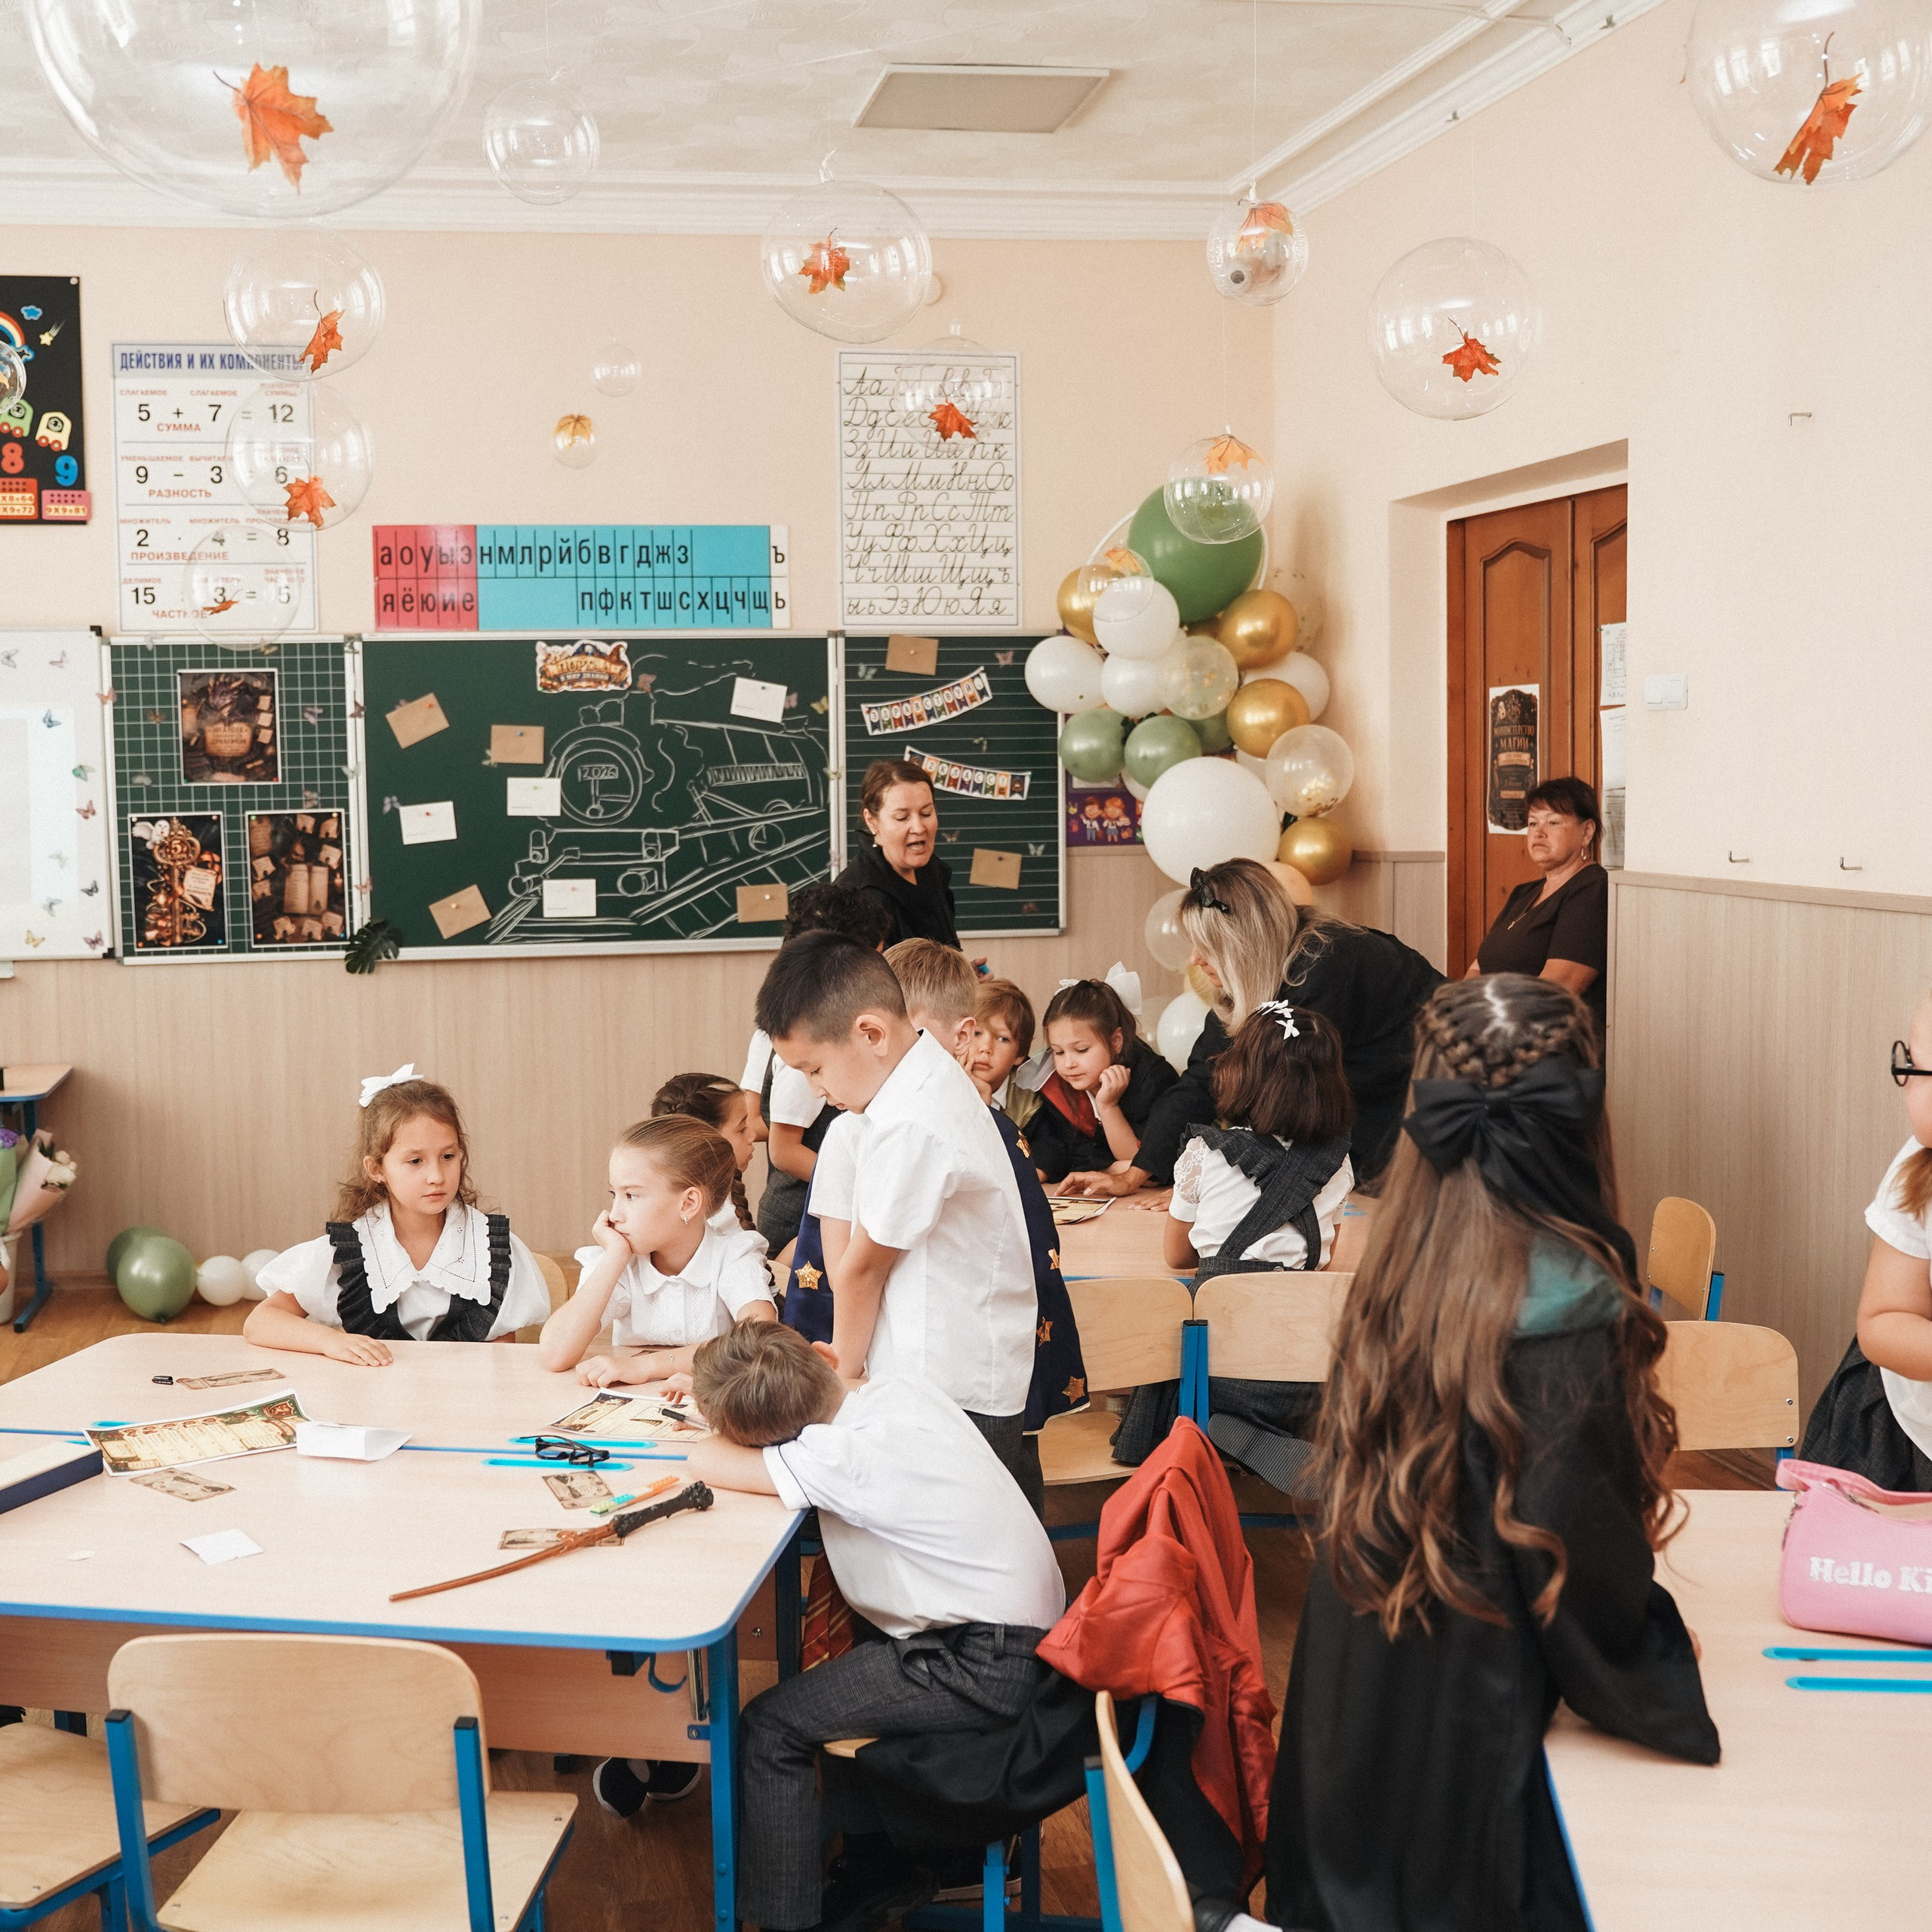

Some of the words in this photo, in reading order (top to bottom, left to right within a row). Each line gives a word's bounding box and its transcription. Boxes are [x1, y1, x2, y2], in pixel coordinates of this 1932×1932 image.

[120, 350, 182, 371] ДЕЙСТВИЯ
[187, 353, 195, 369] И
[200, 353, 214, 369] ИХ
[138, 404, 151, 422] 5
[208, 404, 221, 422] 7
[269, 404, 294, 423] 12
[156, 423, 201, 432] СУММА
[1, 441, 25, 474] 8
[55, 454, 78, 487] 9
[136, 466, 149, 484] 9
[211, 466, 222, 484] 3
[275, 466, 288, 484] 6
[148, 489, 212, 498] РАЗНОСТЬ
[137, 529, 149, 547] 2
[277, 528, 290, 546] 8
[131, 552, 229, 561] ПРОИЗВЕДЕНИЕ
[131, 587, 155, 605] 15
[214, 586, 226, 604] 3
[1500, 737, 1530, 751] МАГИИ
[582, 765, 617, 779] 2026
[929, 761, 937, 771] 2
[1809, 1557, 1892, 1589] Hello
